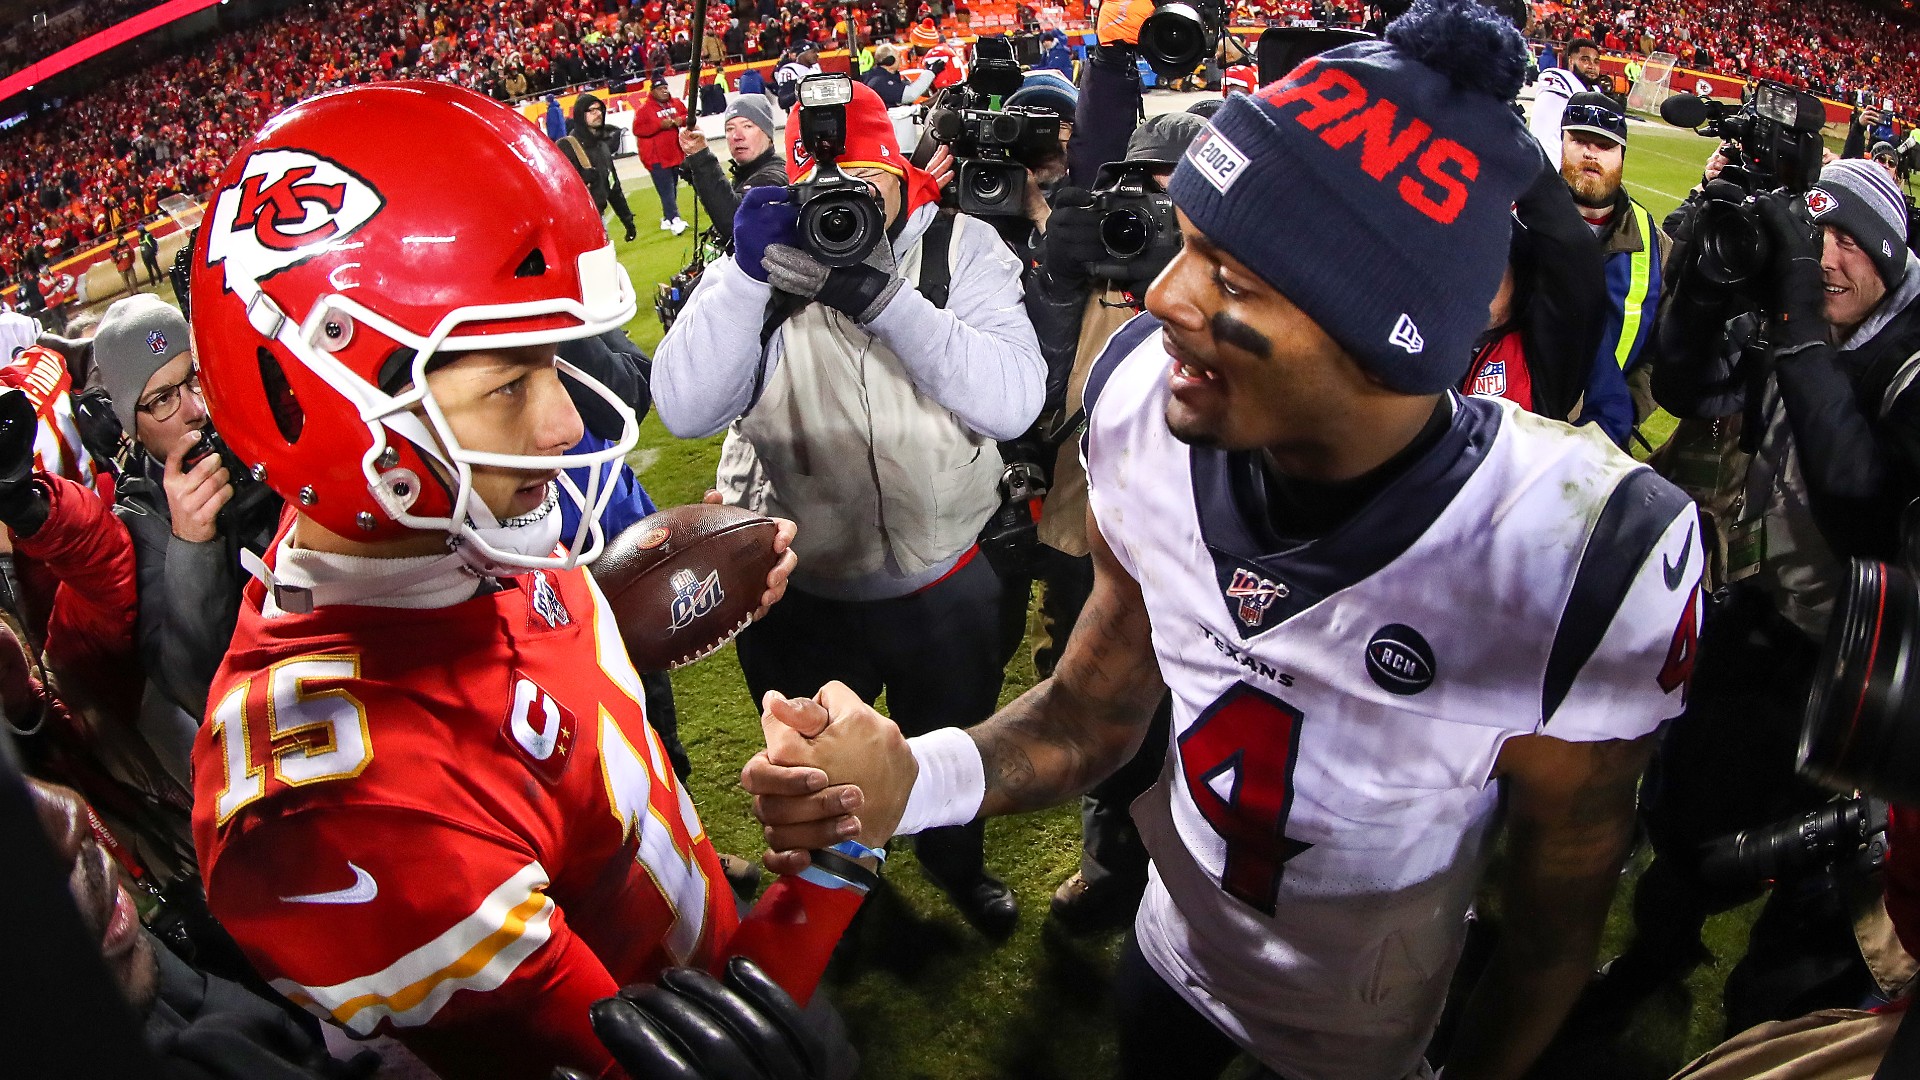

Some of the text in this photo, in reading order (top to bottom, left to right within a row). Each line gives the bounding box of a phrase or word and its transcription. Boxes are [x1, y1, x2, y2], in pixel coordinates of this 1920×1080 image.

[1200, 142, 1236, 179] 2002
[1256, 58, 1480, 224] ANS
[230, 165, 347, 252] KC
[1120, 185, 1142, 193] Canon
[1808, 193, 1827, 212] KC
[1477, 375, 1503, 394] NFL
[1198, 622, 1295, 687] TEXANS
[1381, 647, 1417, 676] RCM
[211, 653, 374, 828] 15
[511, 679, 561, 760] C
[1178, 679, 1315, 918] 4
